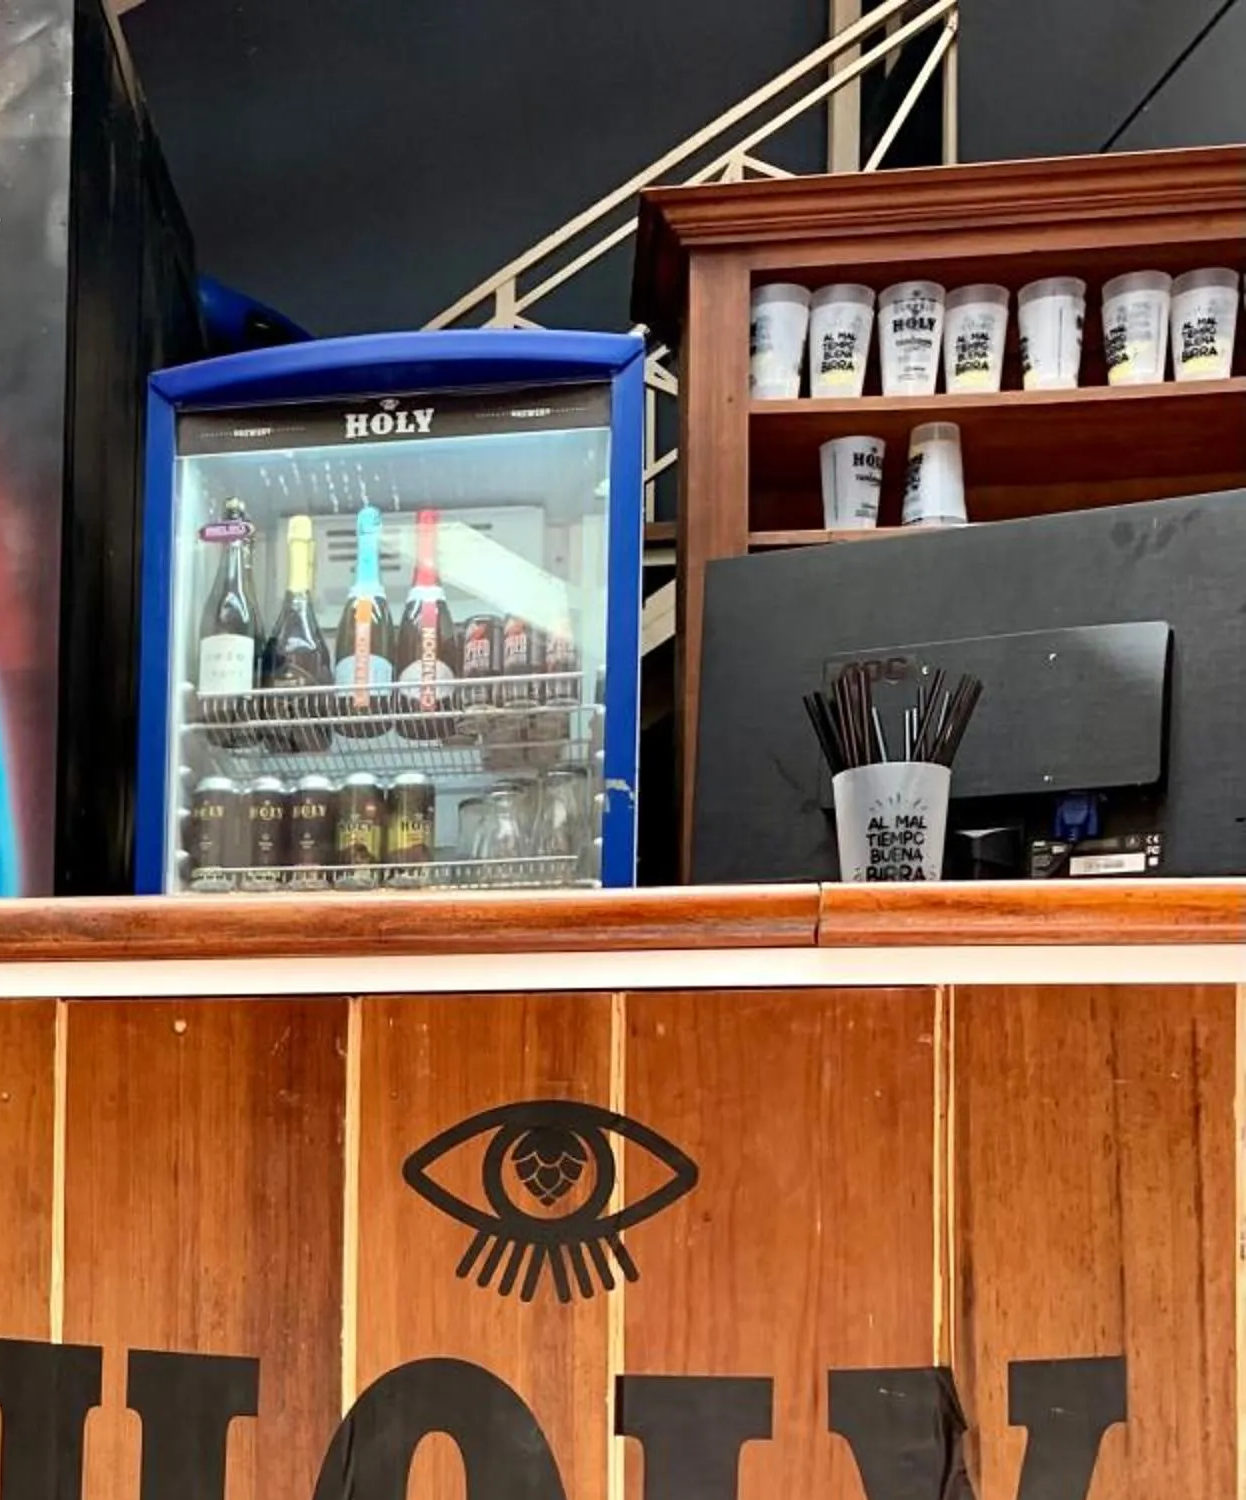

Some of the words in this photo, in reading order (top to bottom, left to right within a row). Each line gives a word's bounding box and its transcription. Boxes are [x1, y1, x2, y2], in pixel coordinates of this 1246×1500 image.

[892, 317, 937, 333] HOLY
[344, 408, 435, 438] HOLY
[867, 816, 889, 830] AL
[895, 815, 928, 830] MAL
[866, 831, 926, 847] TIEMPO
[869, 847, 923, 865] BUENA
[865, 865, 927, 882] BIRRA
